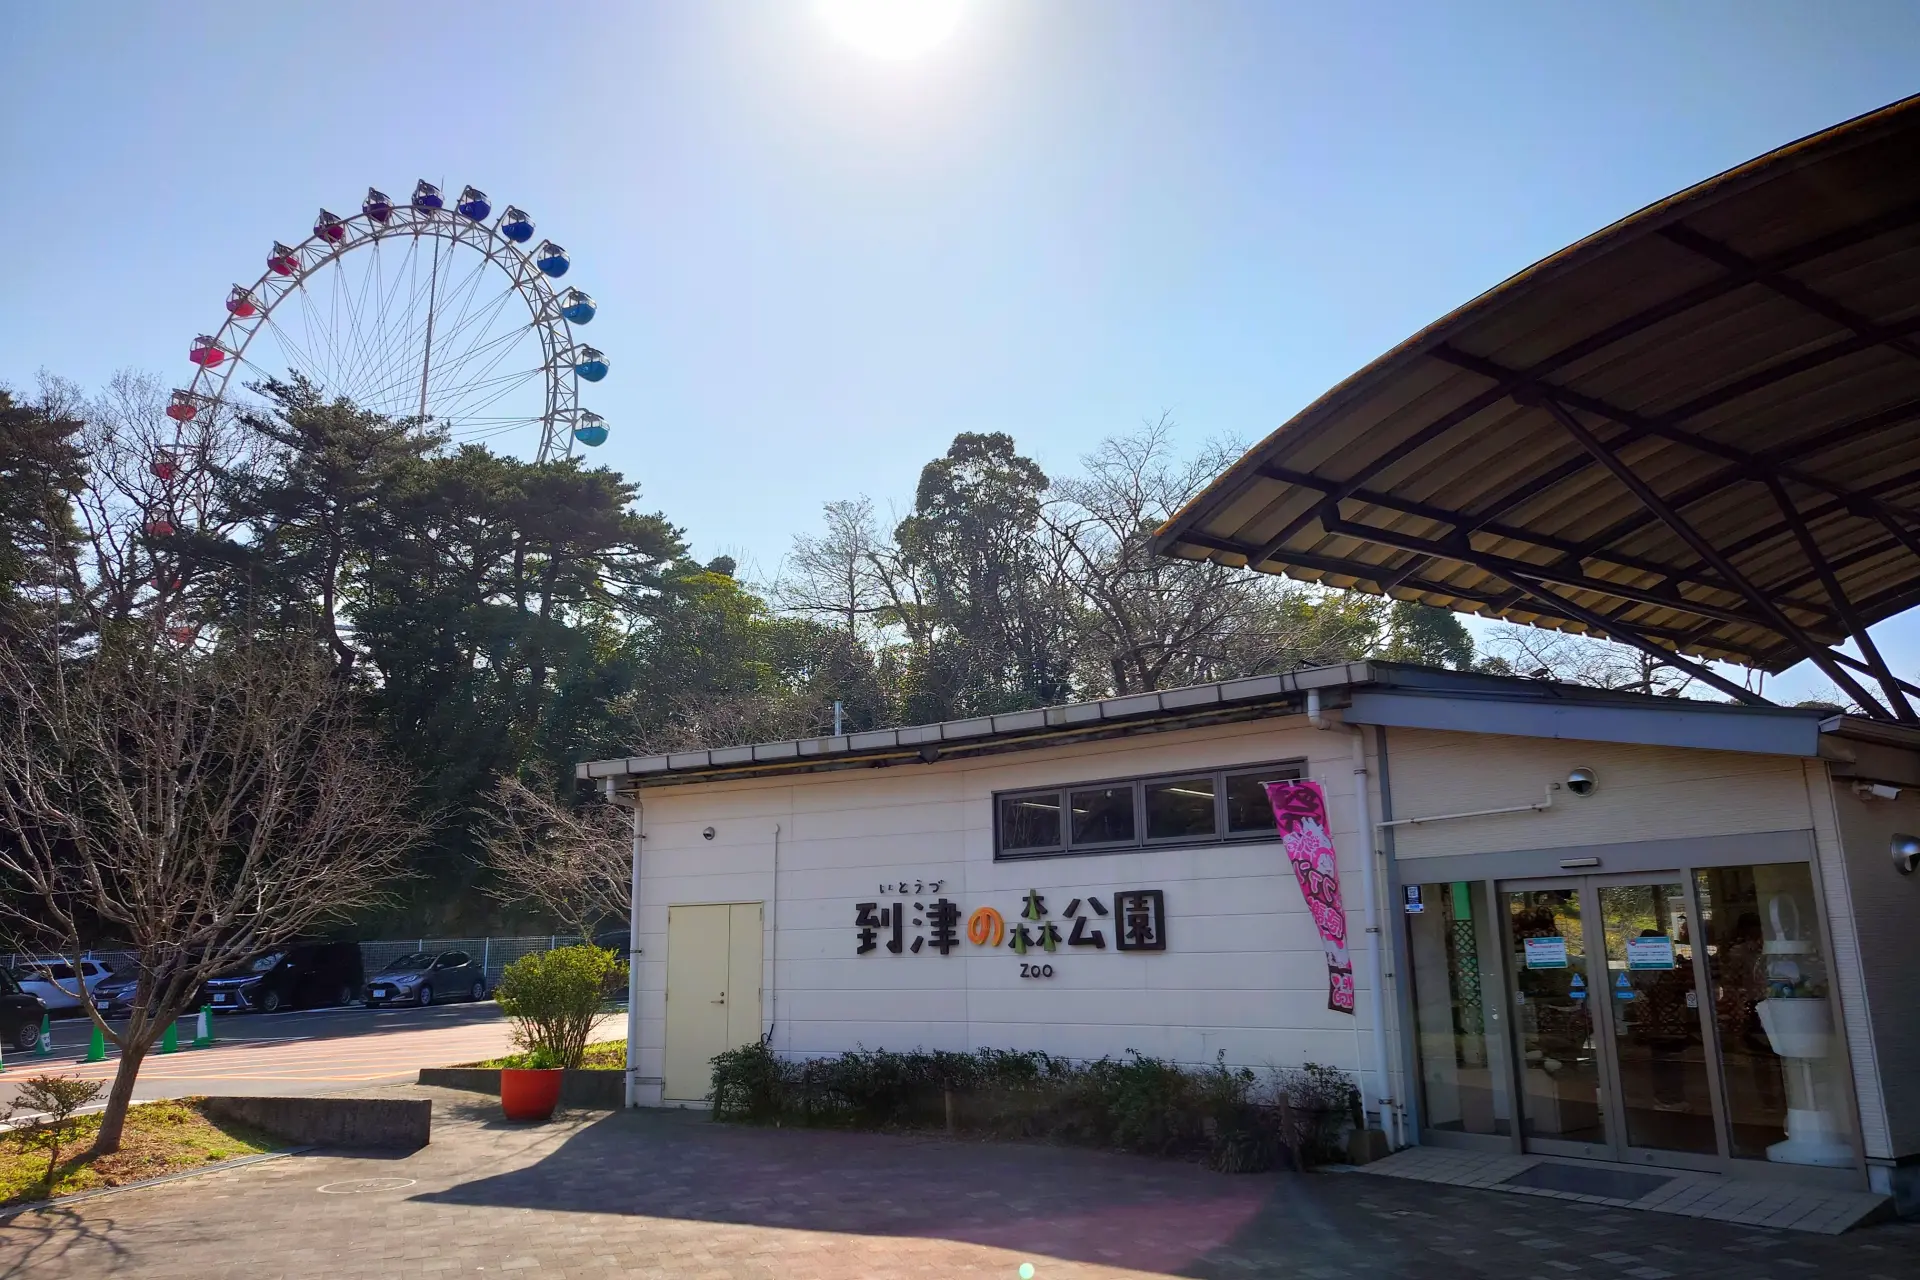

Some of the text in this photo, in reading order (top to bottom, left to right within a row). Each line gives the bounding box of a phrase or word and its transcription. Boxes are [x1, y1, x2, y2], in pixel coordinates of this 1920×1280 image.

[880, 879, 946, 894] いとうづ
[855, 889, 1167, 955] 到津の森公園
